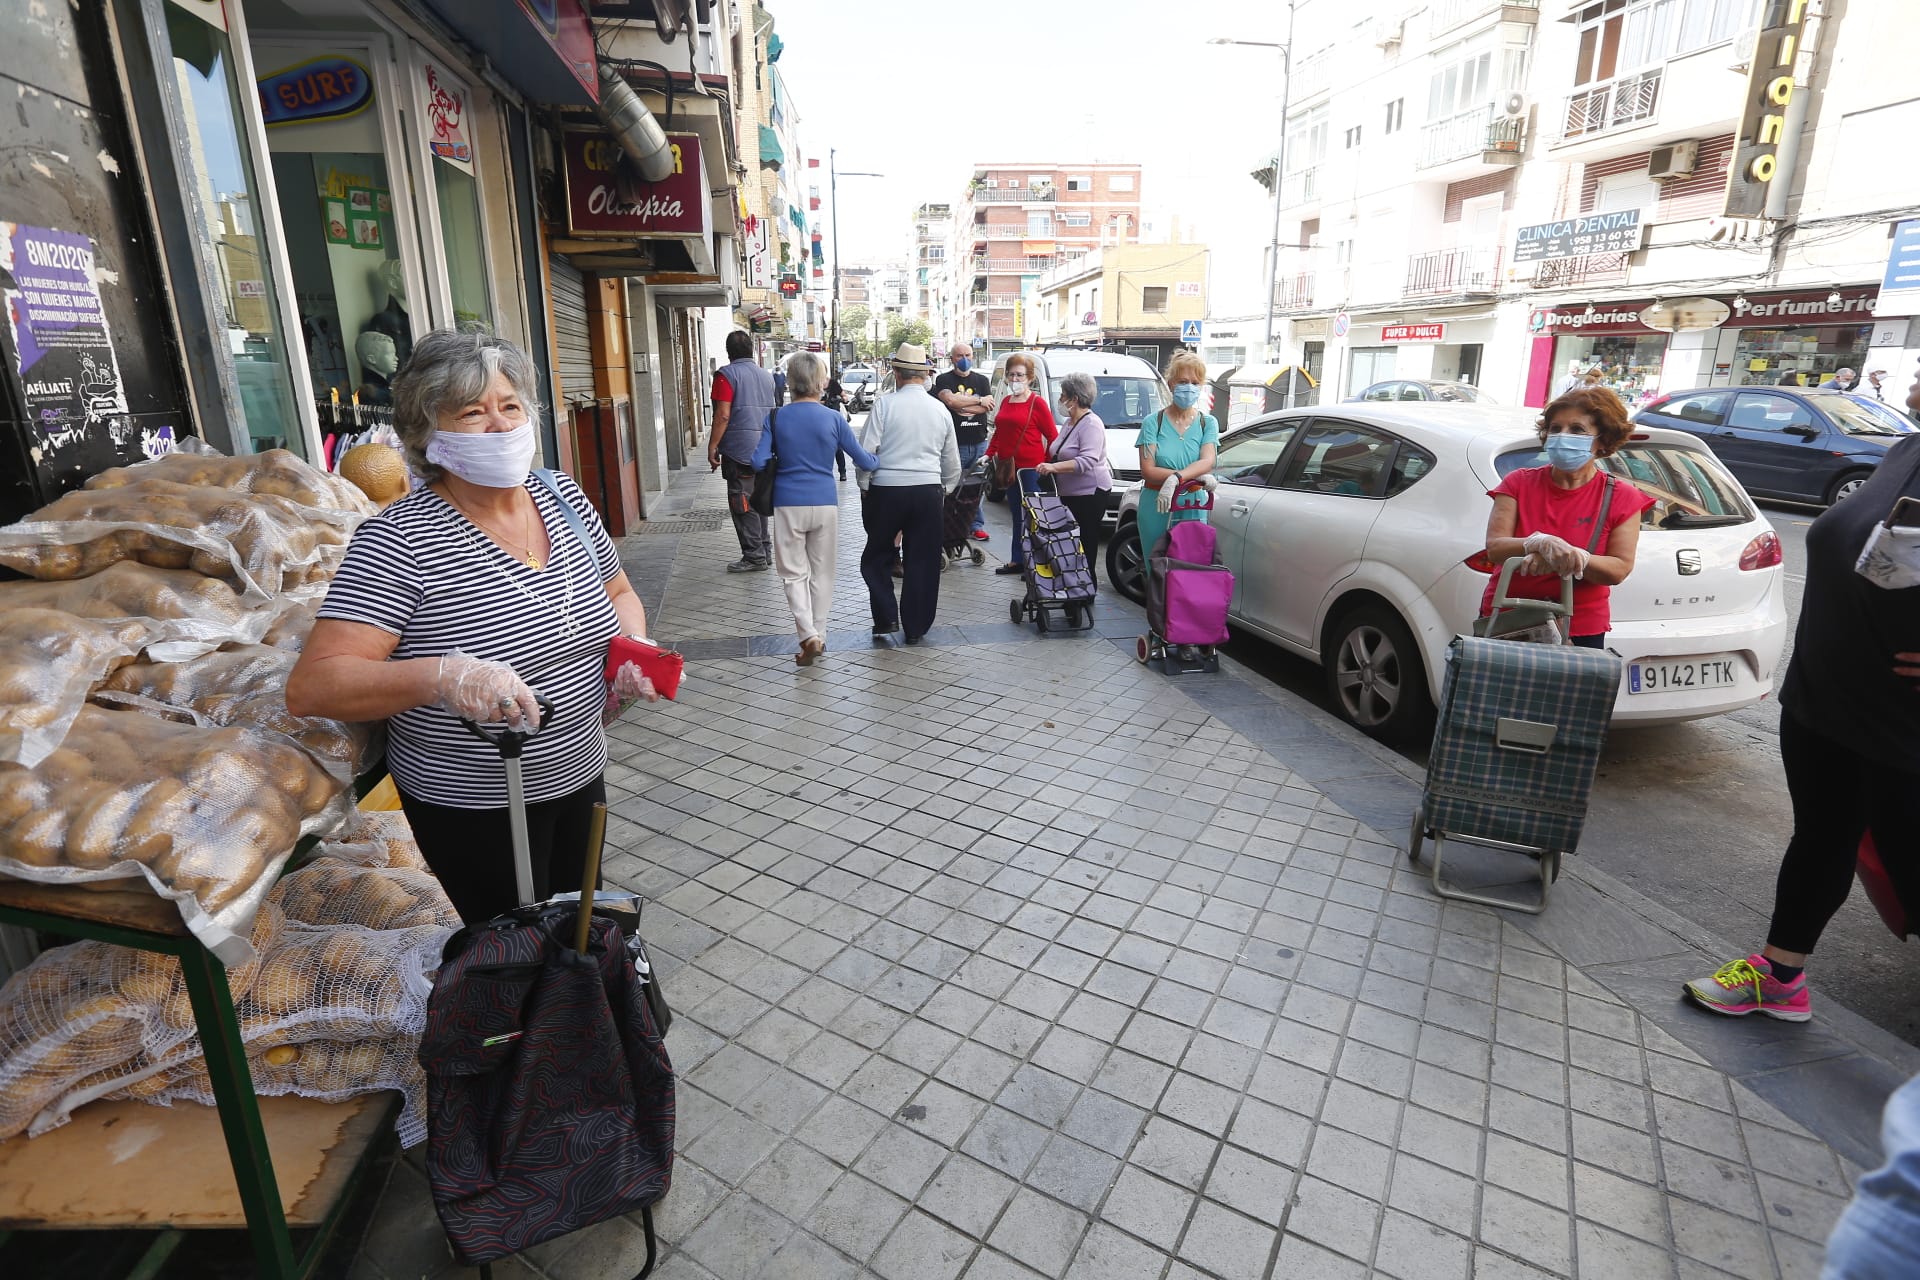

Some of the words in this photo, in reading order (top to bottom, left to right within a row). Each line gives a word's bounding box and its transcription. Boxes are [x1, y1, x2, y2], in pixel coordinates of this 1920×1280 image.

[278, 67, 355, 109] SURF
[1517, 221, 1572, 242] CLINICA
[1578, 211, 1639, 233] DENTAL
[1574, 235, 1592, 246] 958
[1594, 233, 1606, 243] 13
[1608, 231, 1621, 241] 60
[1623, 229, 1637, 239] 90
[1572, 245, 1590, 255] 958
[1592, 243, 1605, 252] 25
[1607, 241, 1620, 250] 70
[1622, 239, 1635, 249] 63
[24, 291, 41, 305] SON
[41, 292, 73, 307] QUIENES
[28, 309, 79, 323] DISCRIMINACIÓN
[1546, 309, 1638, 328] Droguerías
[1385, 328, 1407, 338] SUPER
[1415, 326, 1439, 336] DULCE
[27, 381, 72, 396] AFÍLIATE
[1654, 595, 1716, 606] LEON
[1645, 664, 1695, 689] 9142
[1701, 661, 1734, 685] FTK
